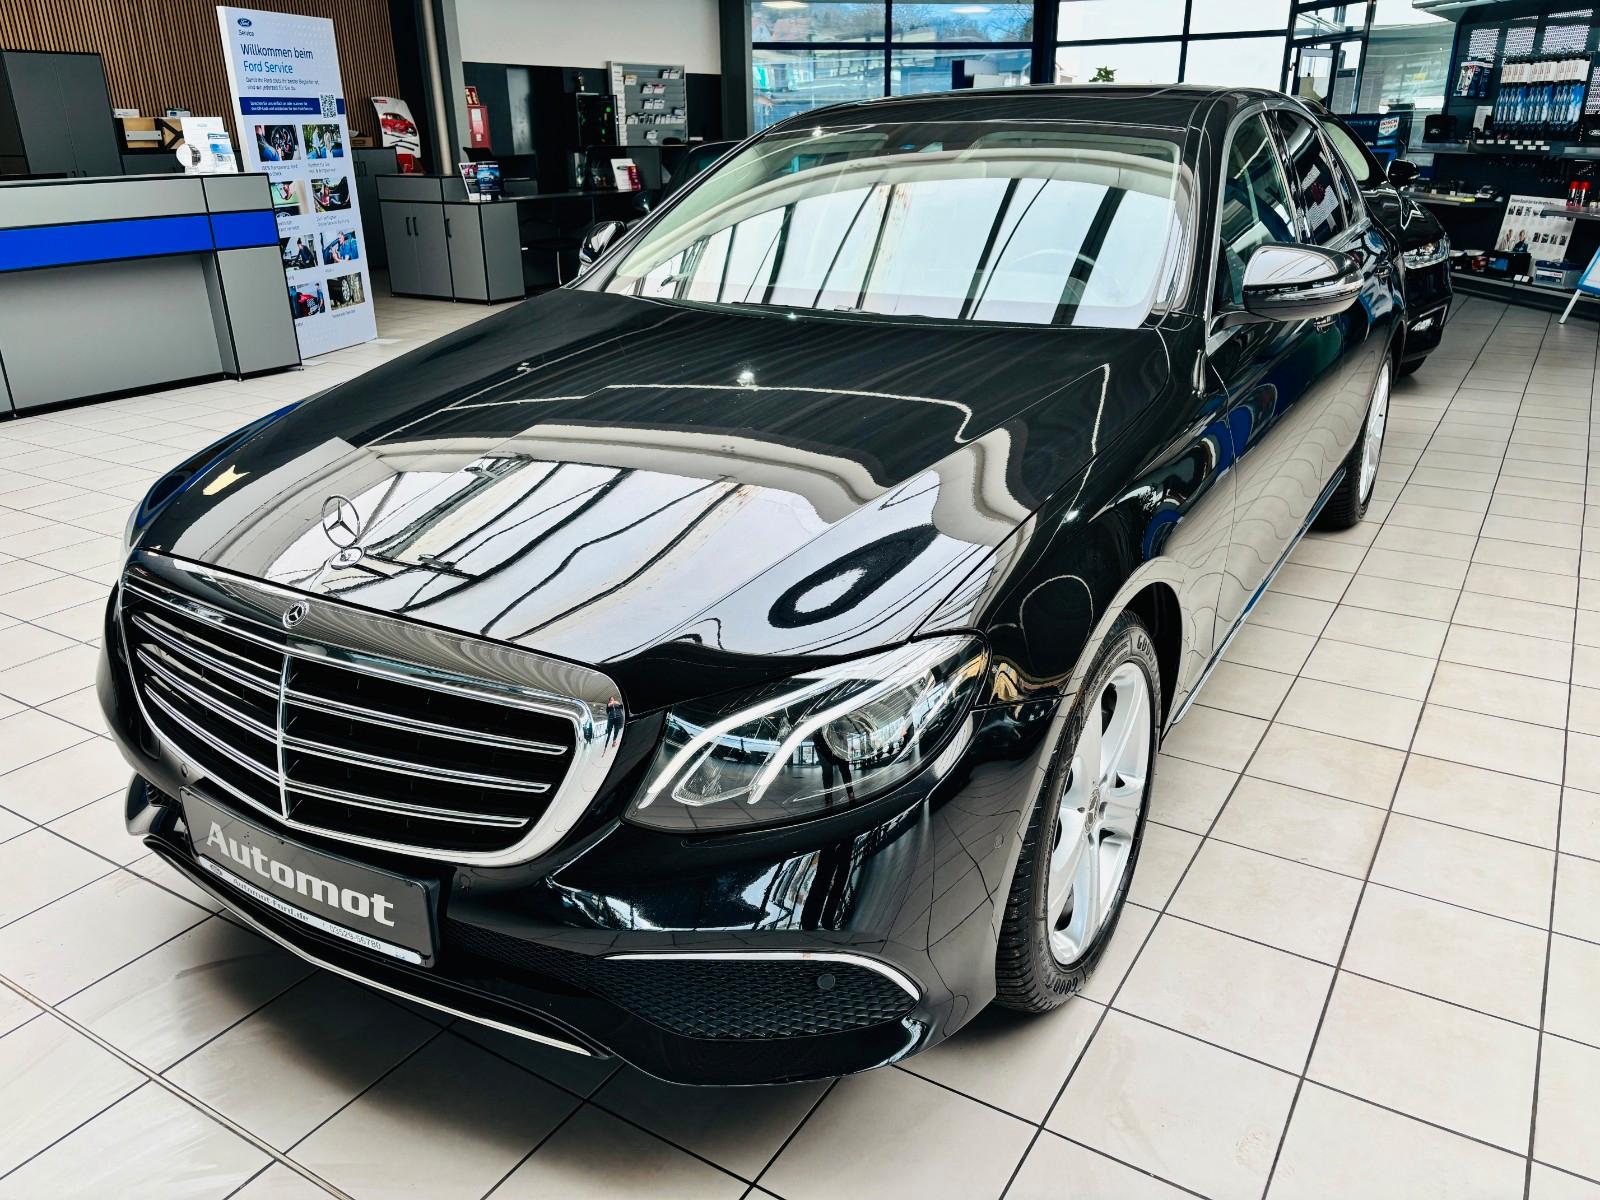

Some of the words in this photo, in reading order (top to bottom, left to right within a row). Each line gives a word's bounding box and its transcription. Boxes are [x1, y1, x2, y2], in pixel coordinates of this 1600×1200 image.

[239, 29, 254, 37] Service
[240, 43, 293, 58] Willkommen
[294, 47, 314, 60] beim
[243, 60, 263, 72] Ford
[264, 61, 294, 74] Service
[206, 821, 395, 927] Automot
